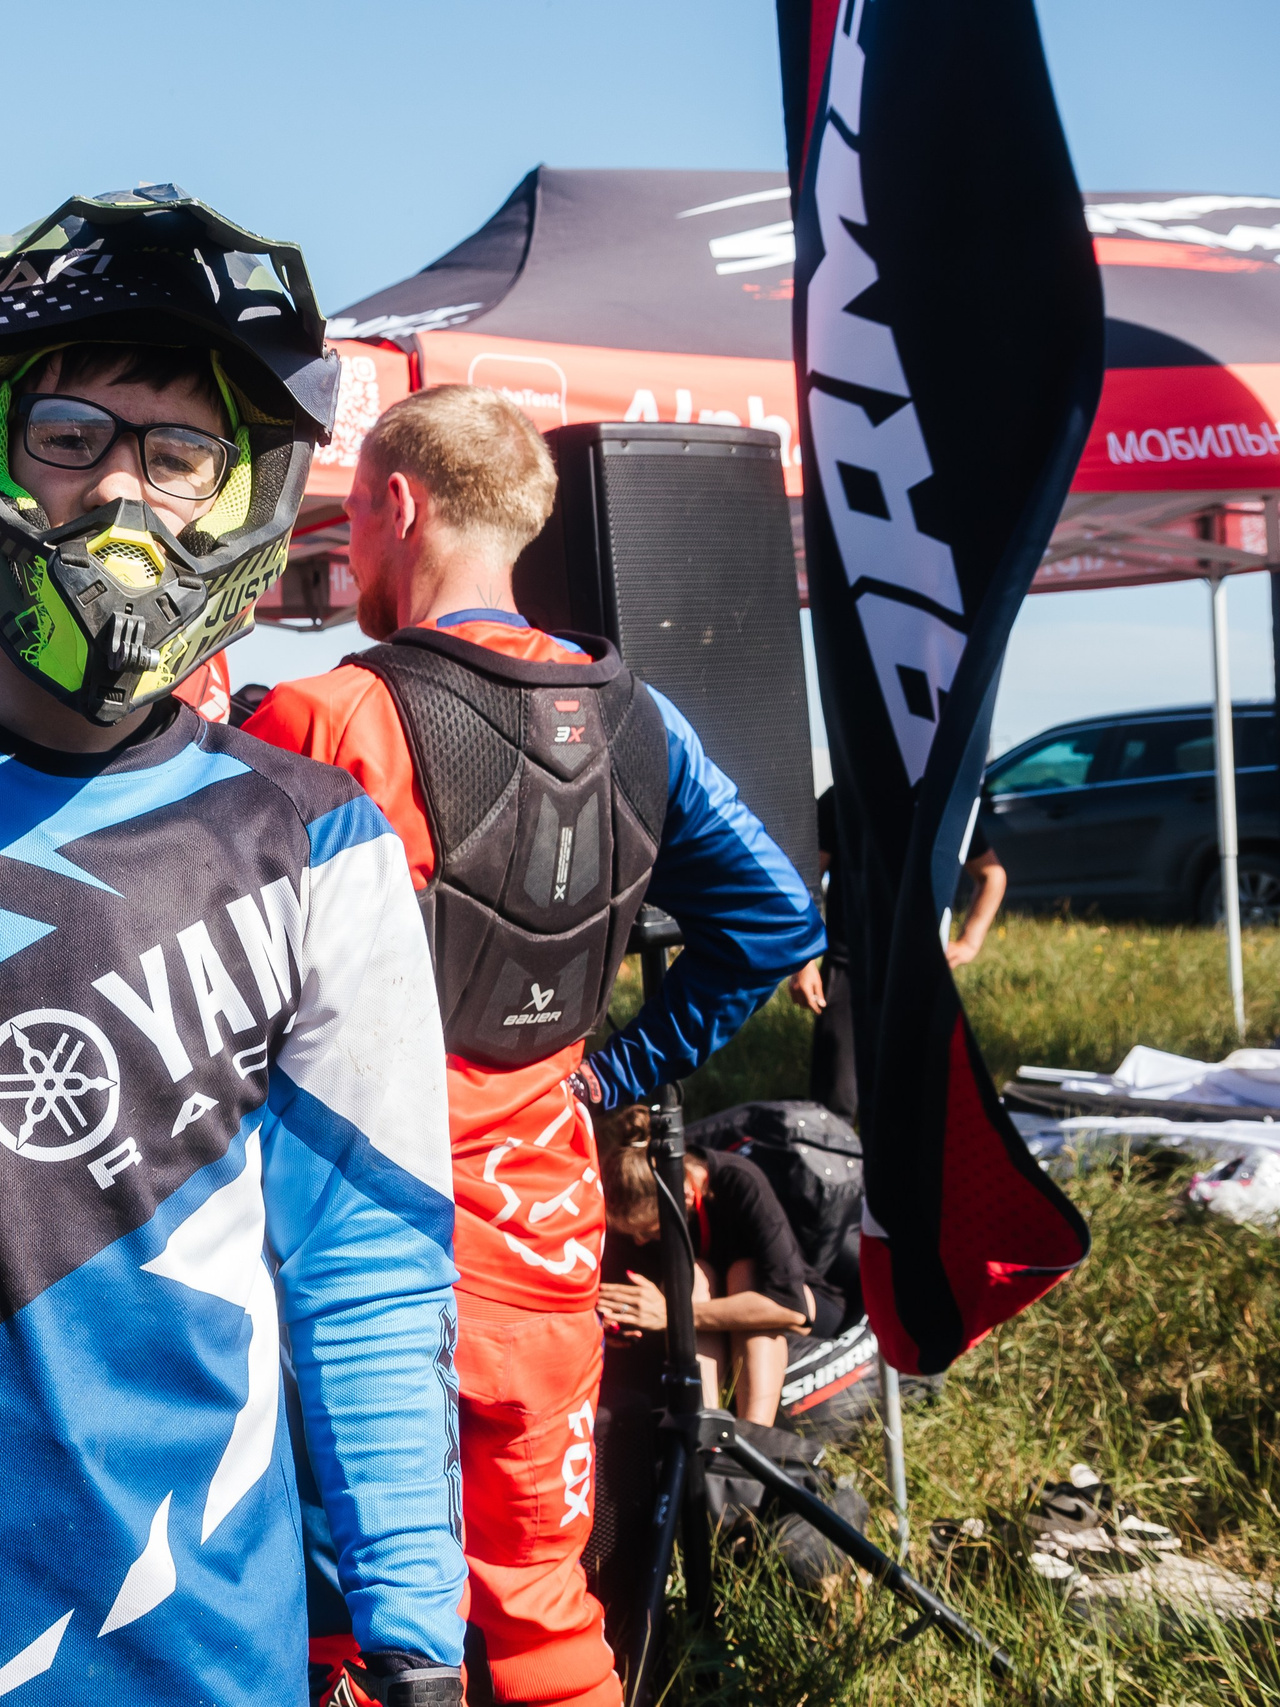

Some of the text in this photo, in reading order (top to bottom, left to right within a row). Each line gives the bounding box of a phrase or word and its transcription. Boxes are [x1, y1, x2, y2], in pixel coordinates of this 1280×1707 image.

[554, 726, 586, 743] 3X
[90, 874, 303, 1083] YAM
[559, 1399, 595, 1528] FOX
